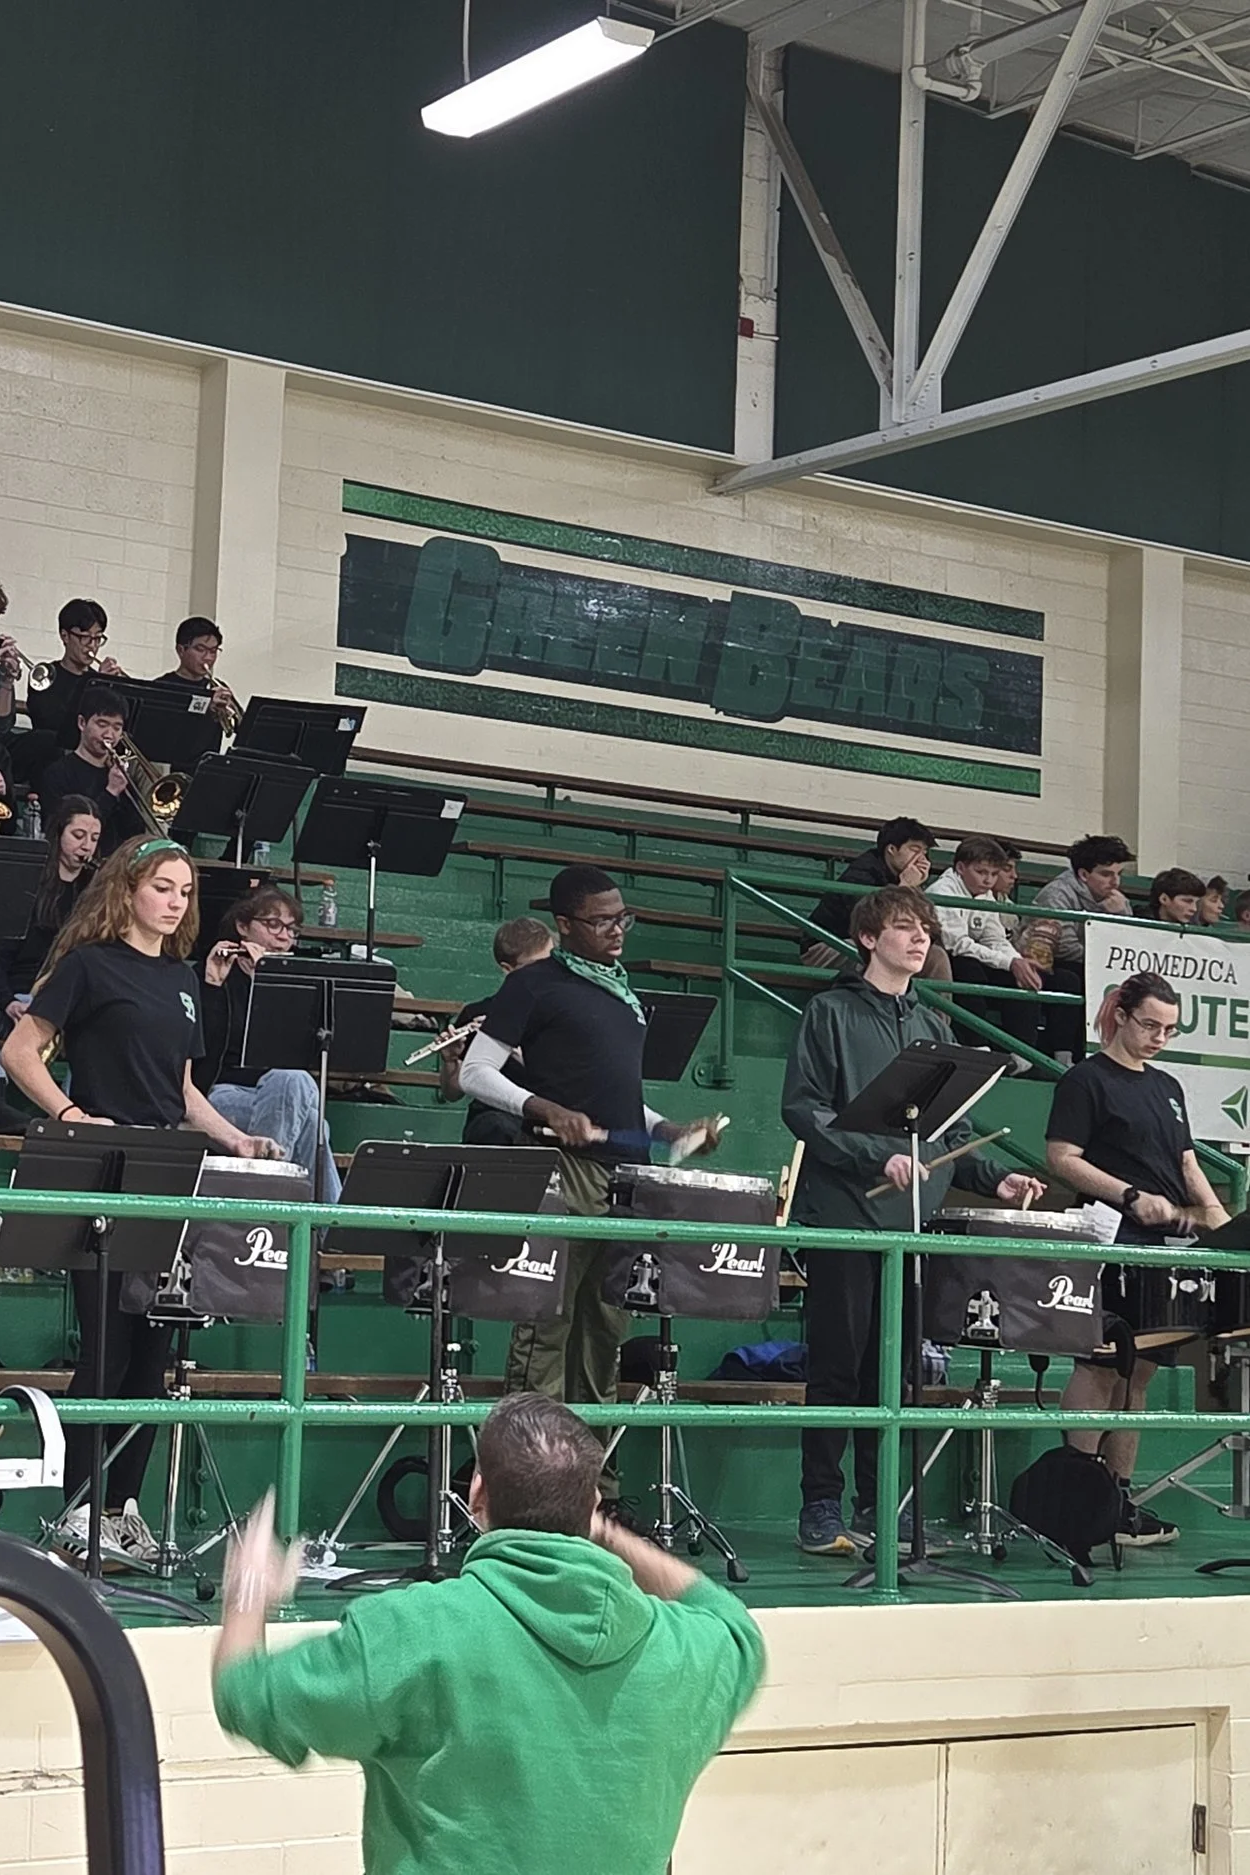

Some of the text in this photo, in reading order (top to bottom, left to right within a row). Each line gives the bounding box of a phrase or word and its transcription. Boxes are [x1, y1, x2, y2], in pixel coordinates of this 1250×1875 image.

[712, 591, 992, 731] BEARS
[1105, 947, 1238, 985] PROMEDICA
[699, 1243, 765, 1273] Pearl
[1037, 1275, 1094, 1309] Pearl
